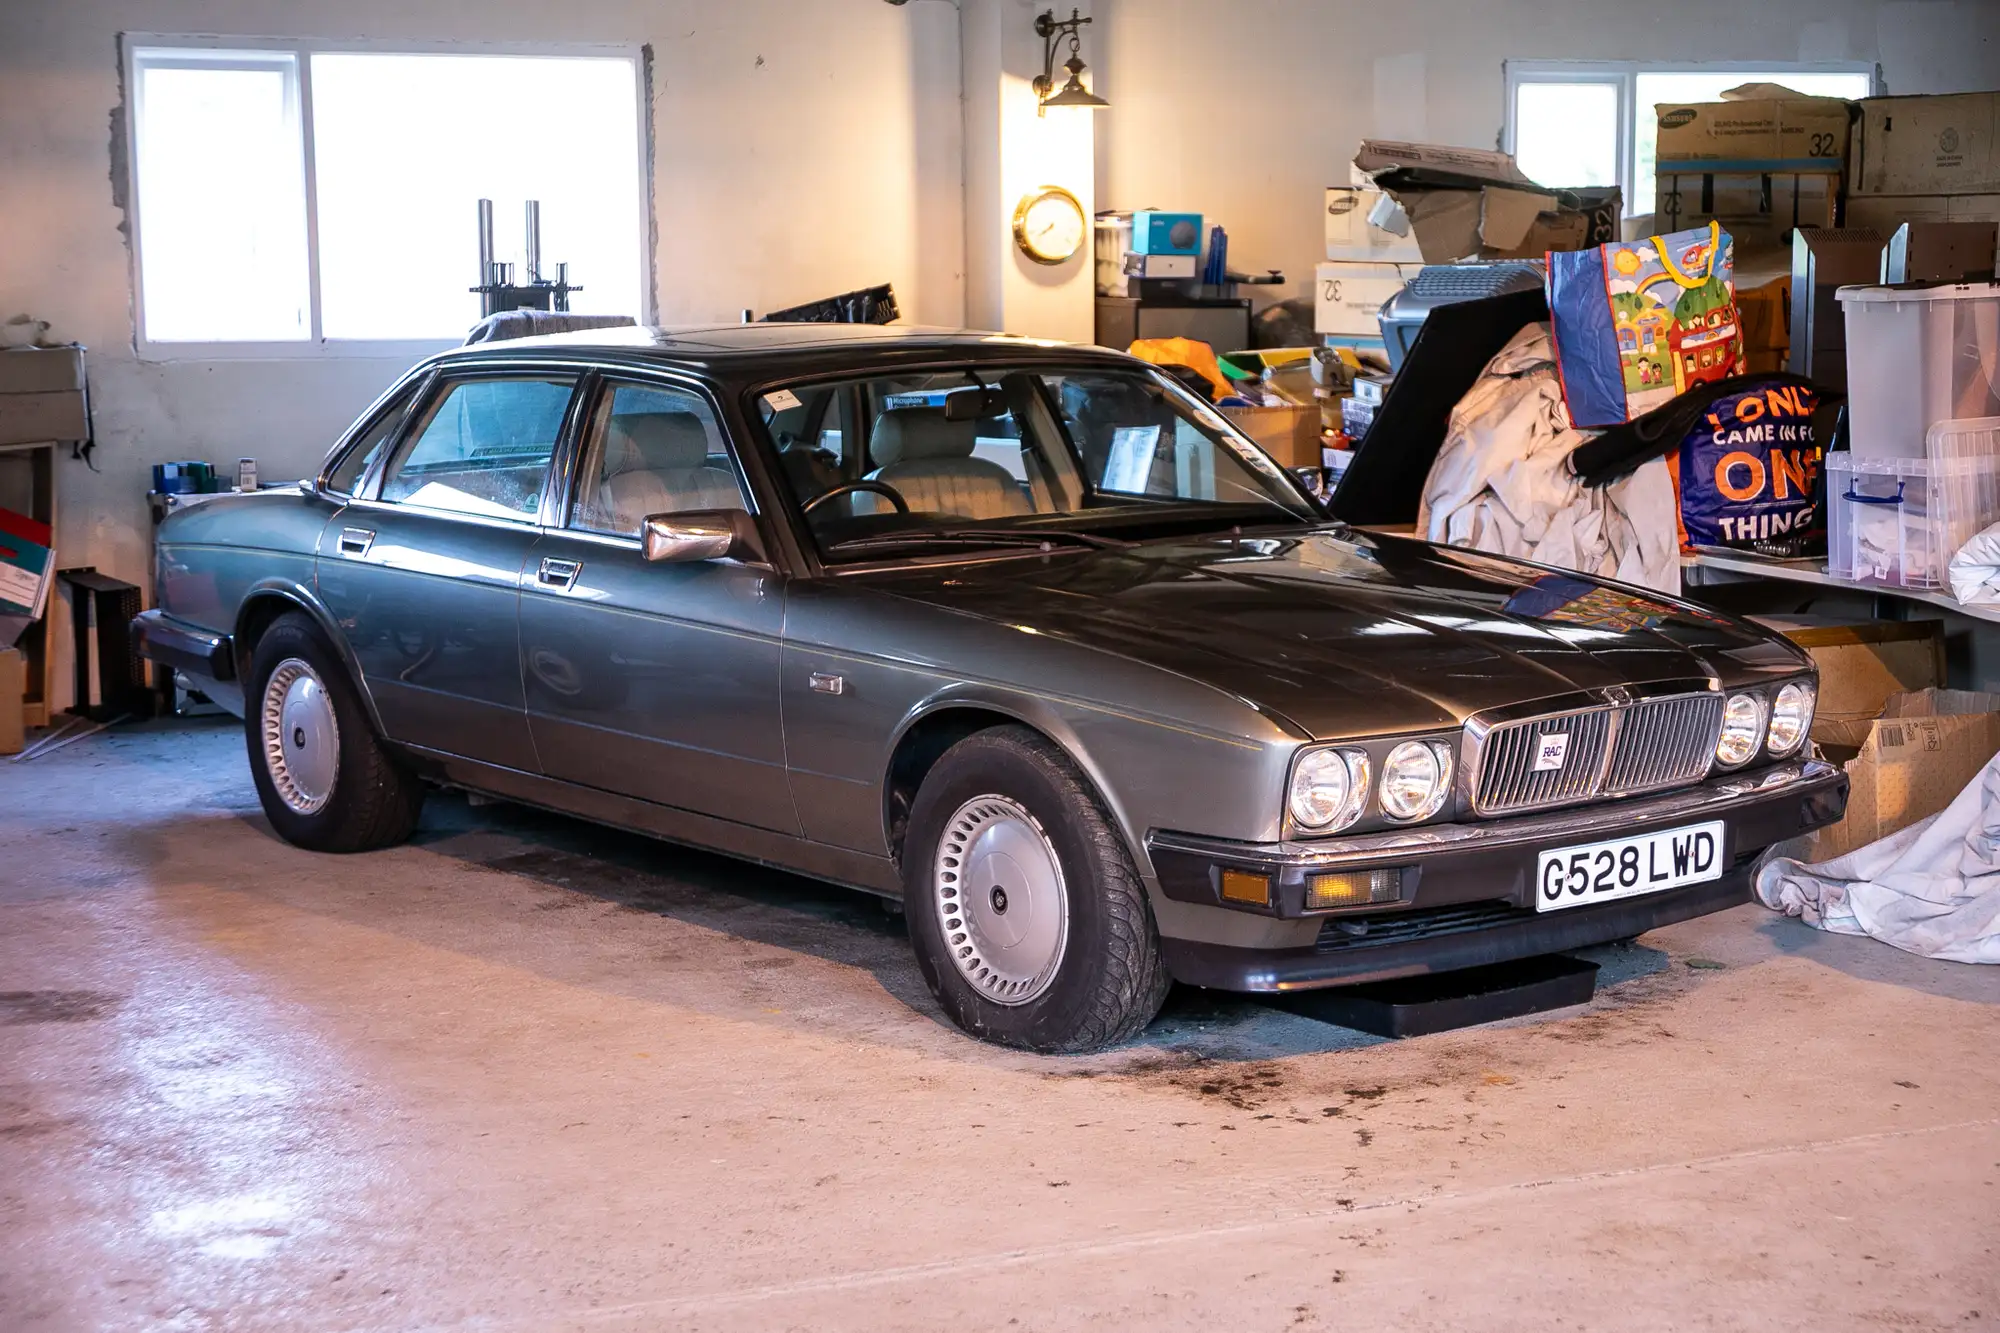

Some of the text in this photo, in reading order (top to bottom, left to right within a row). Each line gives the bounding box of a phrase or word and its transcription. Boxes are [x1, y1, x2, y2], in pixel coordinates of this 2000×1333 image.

[1809, 133, 1835, 157] 32
[1325, 279, 1342, 301] 32
[1713, 424, 1775, 446] CAME
[1779, 424, 1797, 442] IN
[1718, 507, 1813, 541] THING
[1542, 745, 1562, 757] RAC
[1543, 831, 1715, 901] G528 LWD
